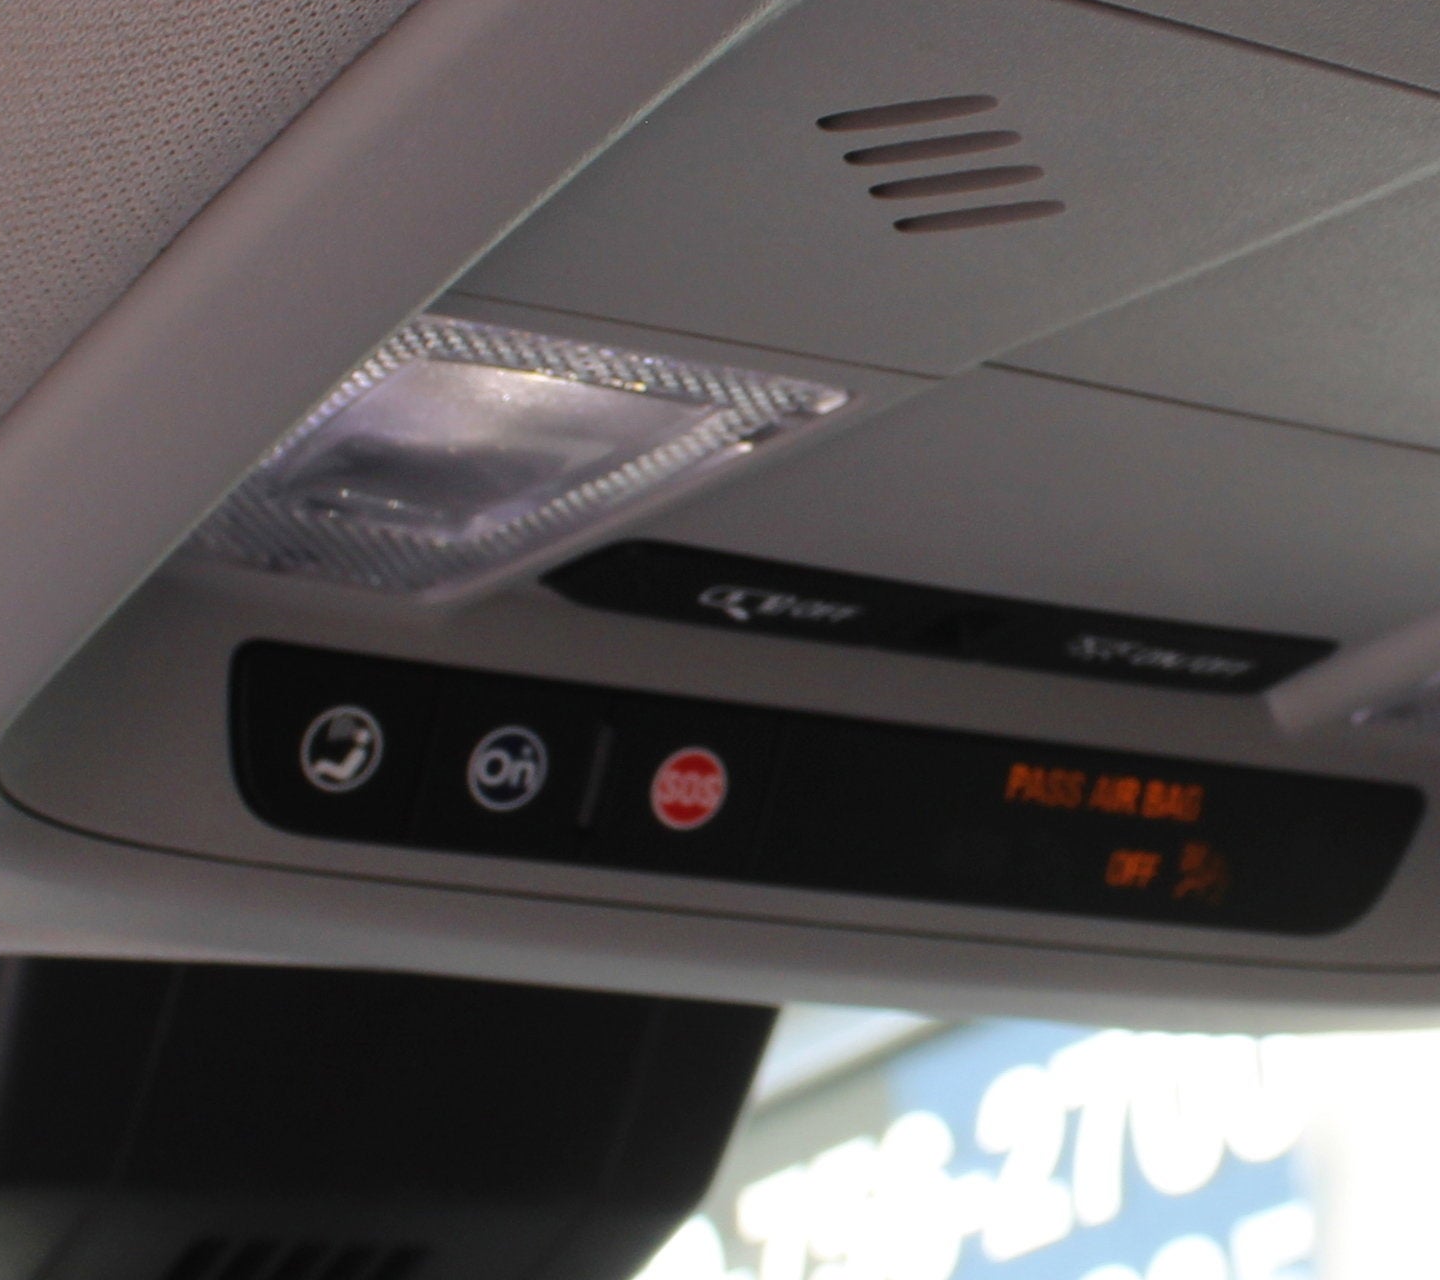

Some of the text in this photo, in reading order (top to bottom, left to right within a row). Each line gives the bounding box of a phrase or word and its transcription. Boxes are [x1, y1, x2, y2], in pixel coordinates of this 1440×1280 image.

[654, 769, 724, 808] SOS
[1005, 761, 1087, 810] PASS
[1104, 848, 1164, 889] OFF
